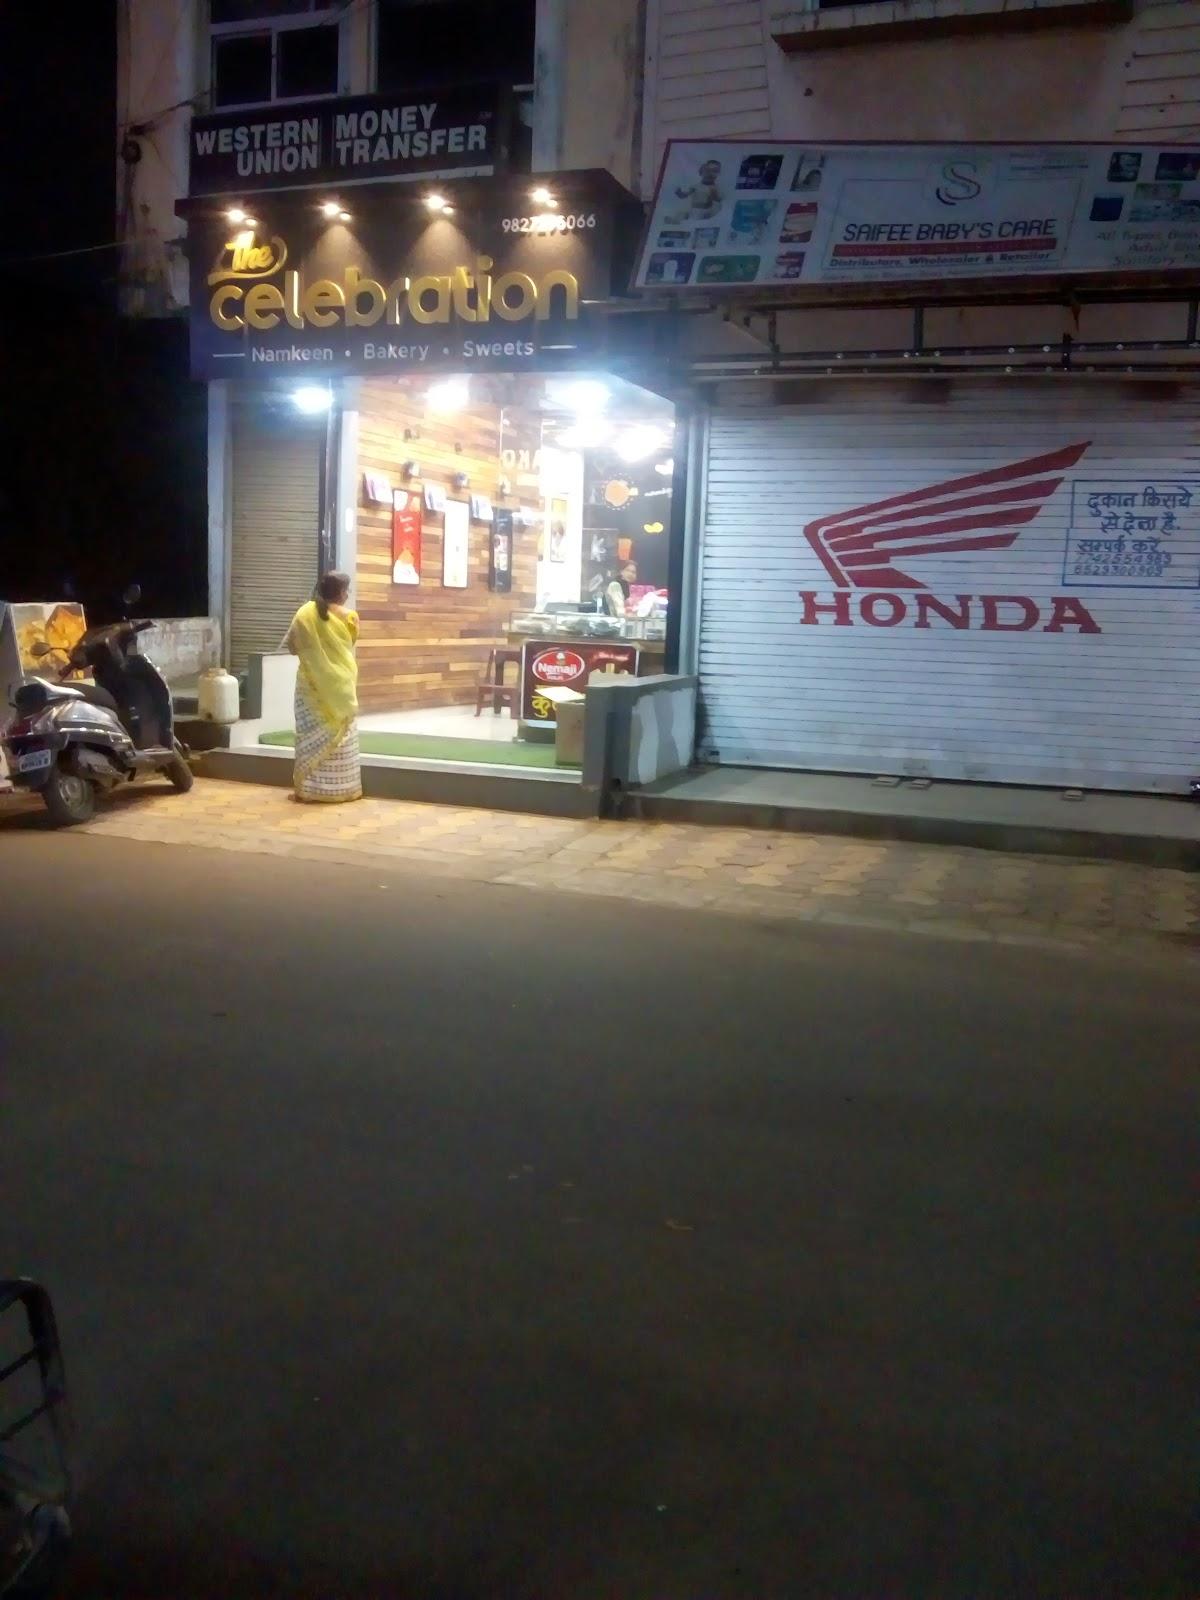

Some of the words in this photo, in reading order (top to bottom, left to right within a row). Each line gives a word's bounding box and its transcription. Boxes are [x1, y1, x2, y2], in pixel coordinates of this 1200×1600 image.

[195, 118, 319, 156] WESTERN
[335, 104, 438, 139] MONEY
[236, 145, 319, 176] UNION
[335, 125, 487, 165] TRANSFER
[843, 223, 912, 242] SAIFEE
[916, 221, 993, 241] BABY'S
[998, 219, 1057, 237] CARE
[209, 257, 579, 331] celebration
[251, 345, 334, 363] Namkeen
[363, 342, 429, 362] Bakery
[463, 340, 534, 358] Sweets
[798, 590, 1102, 634] HONDA
